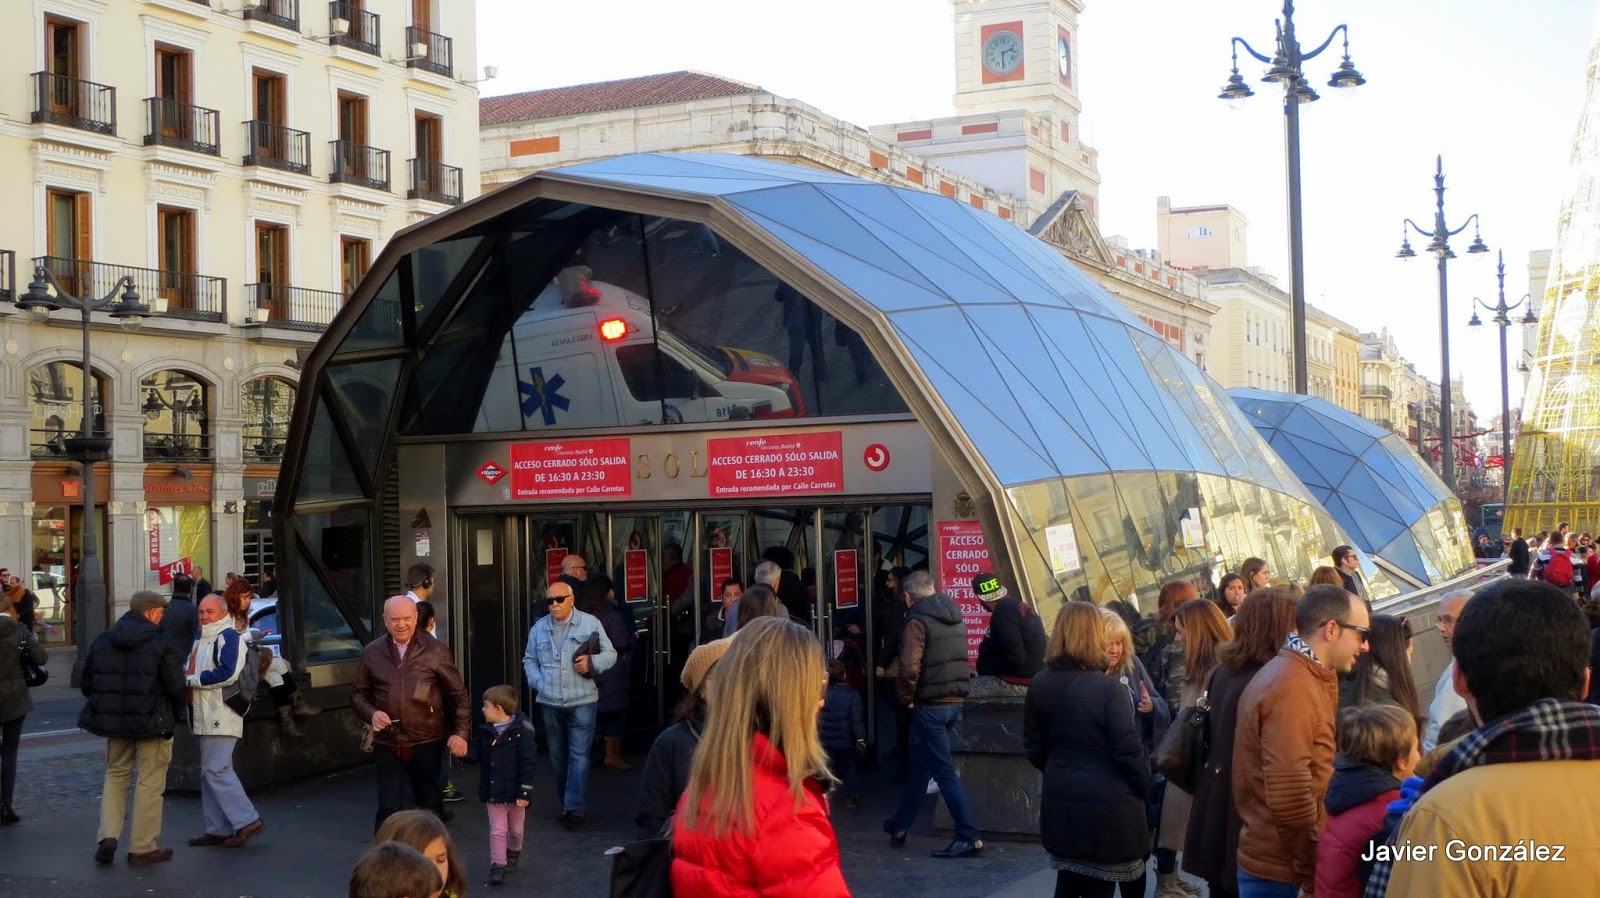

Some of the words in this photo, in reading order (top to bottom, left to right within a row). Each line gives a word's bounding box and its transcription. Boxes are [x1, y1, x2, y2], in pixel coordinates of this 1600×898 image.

[746, 438, 766, 447] renfe
[544, 444, 563, 453] renfe
[514, 460, 541, 469] ACCESO
[543, 459, 577, 468] CERRADO
[579, 456, 598, 466] SÓLO
[600, 456, 626, 465] SALIDA
[712, 456, 742, 466] ACCESO
[745, 453, 783, 464] CERRADO
[785, 451, 806, 462] SÓLO
[809, 450, 838, 460] SALIDA
[637, 450, 708, 479] SOL
[535, 473, 546, 483] DE
[548, 472, 572, 482] 16:30
[573, 471, 579, 481] A
[581, 470, 605, 481] 23:30
[735, 469, 747, 479] DE
[751, 468, 776, 478] 16:30
[778, 467, 785, 477] A
[787, 466, 814, 477] 23:30
[517, 488, 538, 496] Entrada
[539, 487, 574, 495] recomendada
[586, 485, 600, 493] Calle
[740, 484, 780, 492] recomendada
[793, 482, 809, 490] Calle
[950, 536, 984, 546] ACCESO
[946, 550, 988, 560] CERRADO
[955, 562, 979, 573] SÓLO
[979, 578, 999, 593] DOPE
[947, 589, 960, 598] DE
